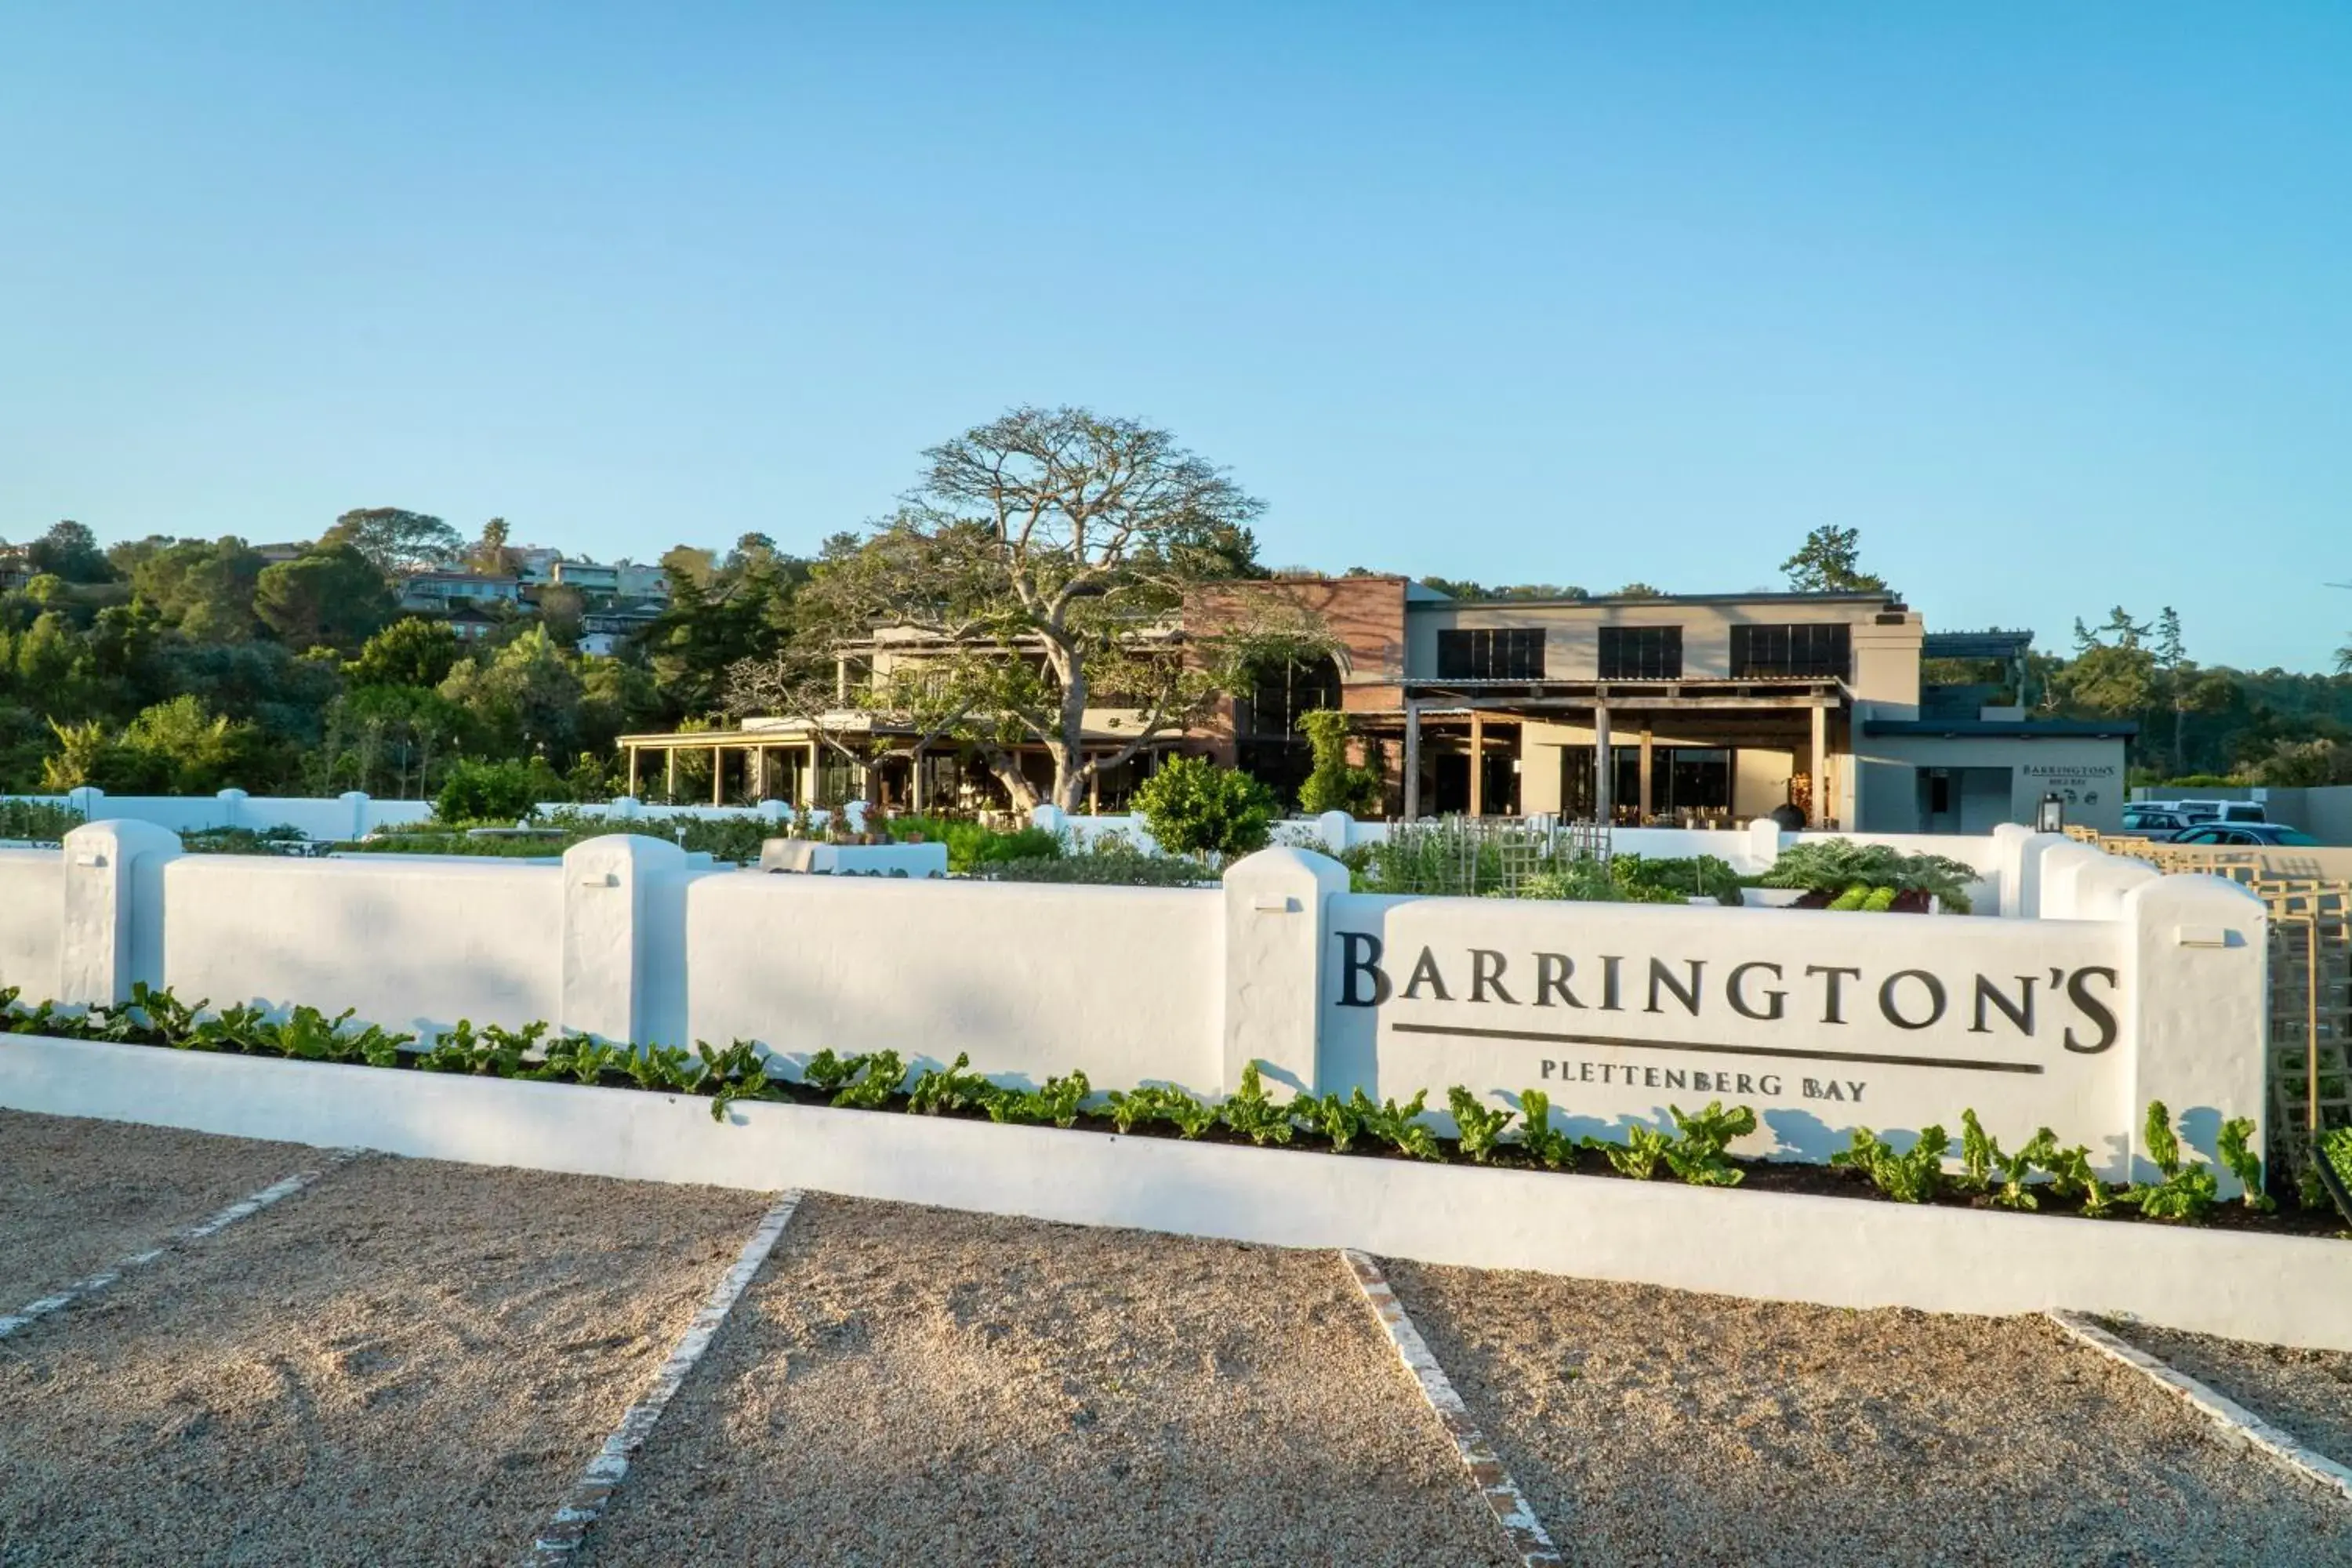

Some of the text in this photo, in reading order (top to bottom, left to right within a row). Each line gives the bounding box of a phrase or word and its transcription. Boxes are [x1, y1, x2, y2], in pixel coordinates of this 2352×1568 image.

[1334, 930, 2118, 1054] BARRINGTON'S
[1541, 1059, 1867, 1102] PLETTENBERG BAY
